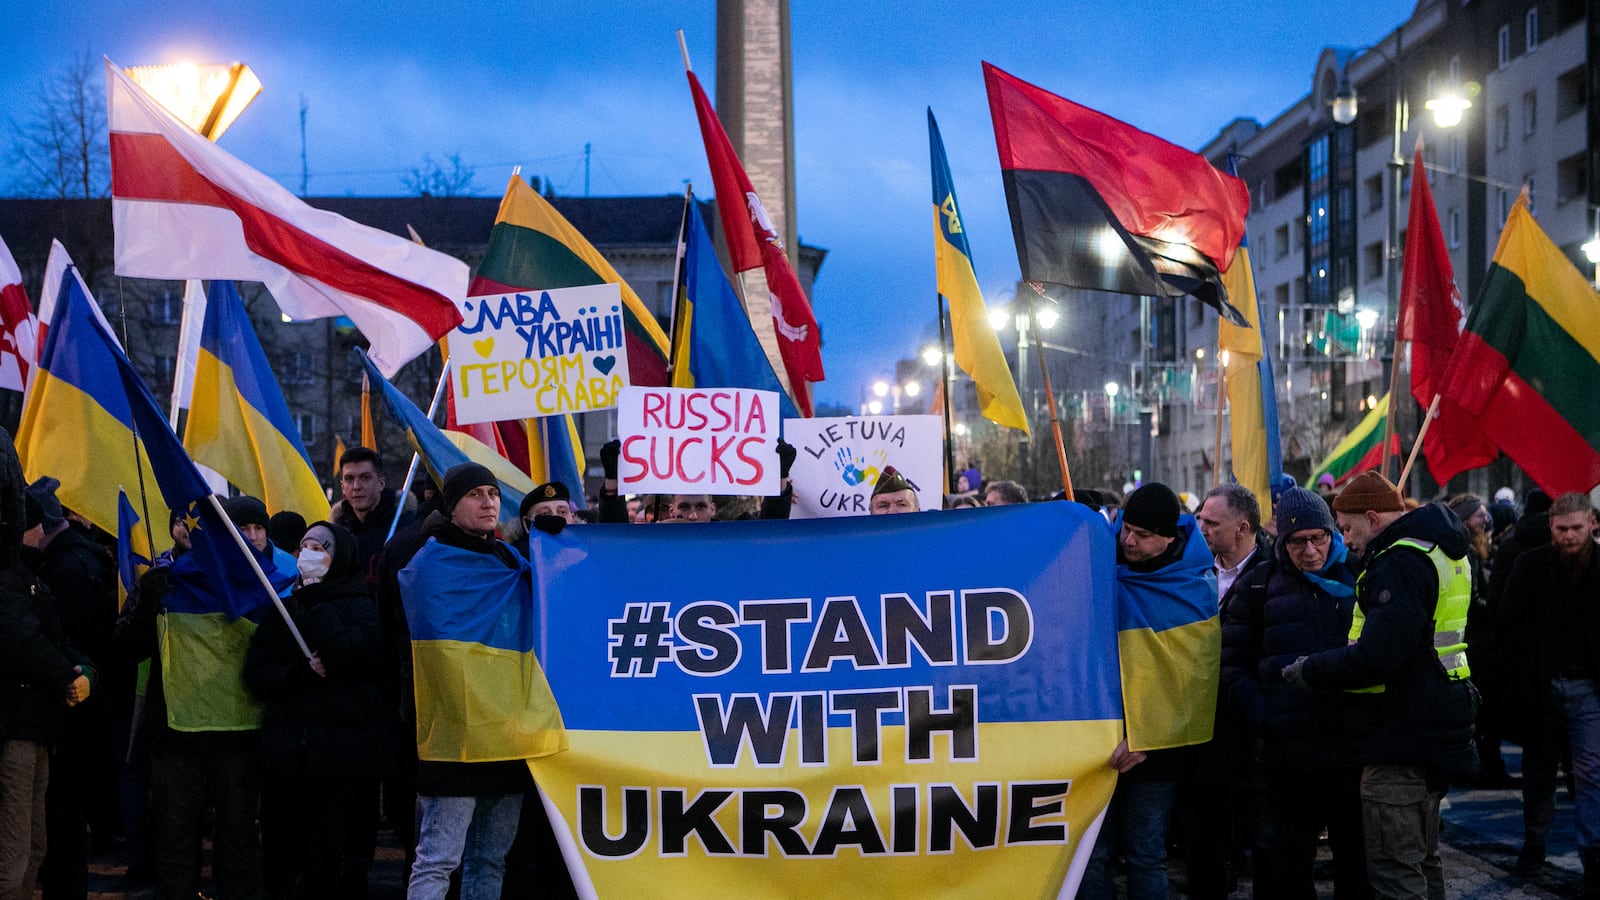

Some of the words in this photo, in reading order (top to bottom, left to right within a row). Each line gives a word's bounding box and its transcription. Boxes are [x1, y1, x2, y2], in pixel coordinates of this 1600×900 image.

[457, 291, 560, 334] СЛАВА
[516, 305, 622, 359] УКРАЇНІ
[460, 353, 584, 398] ГЕРОЯМ
[535, 373, 624, 414] СЛАВА
[643, 391, 766, 434] RUSSIA
[622, 435, 766, 486] SUCKS
[804, 421, 905, 459] LIETUVA
[608, 587, 1034, 678] #STAND
[692, 684, 980, 769] WITH
[576, 779, 1072, 860] UKRAINE
